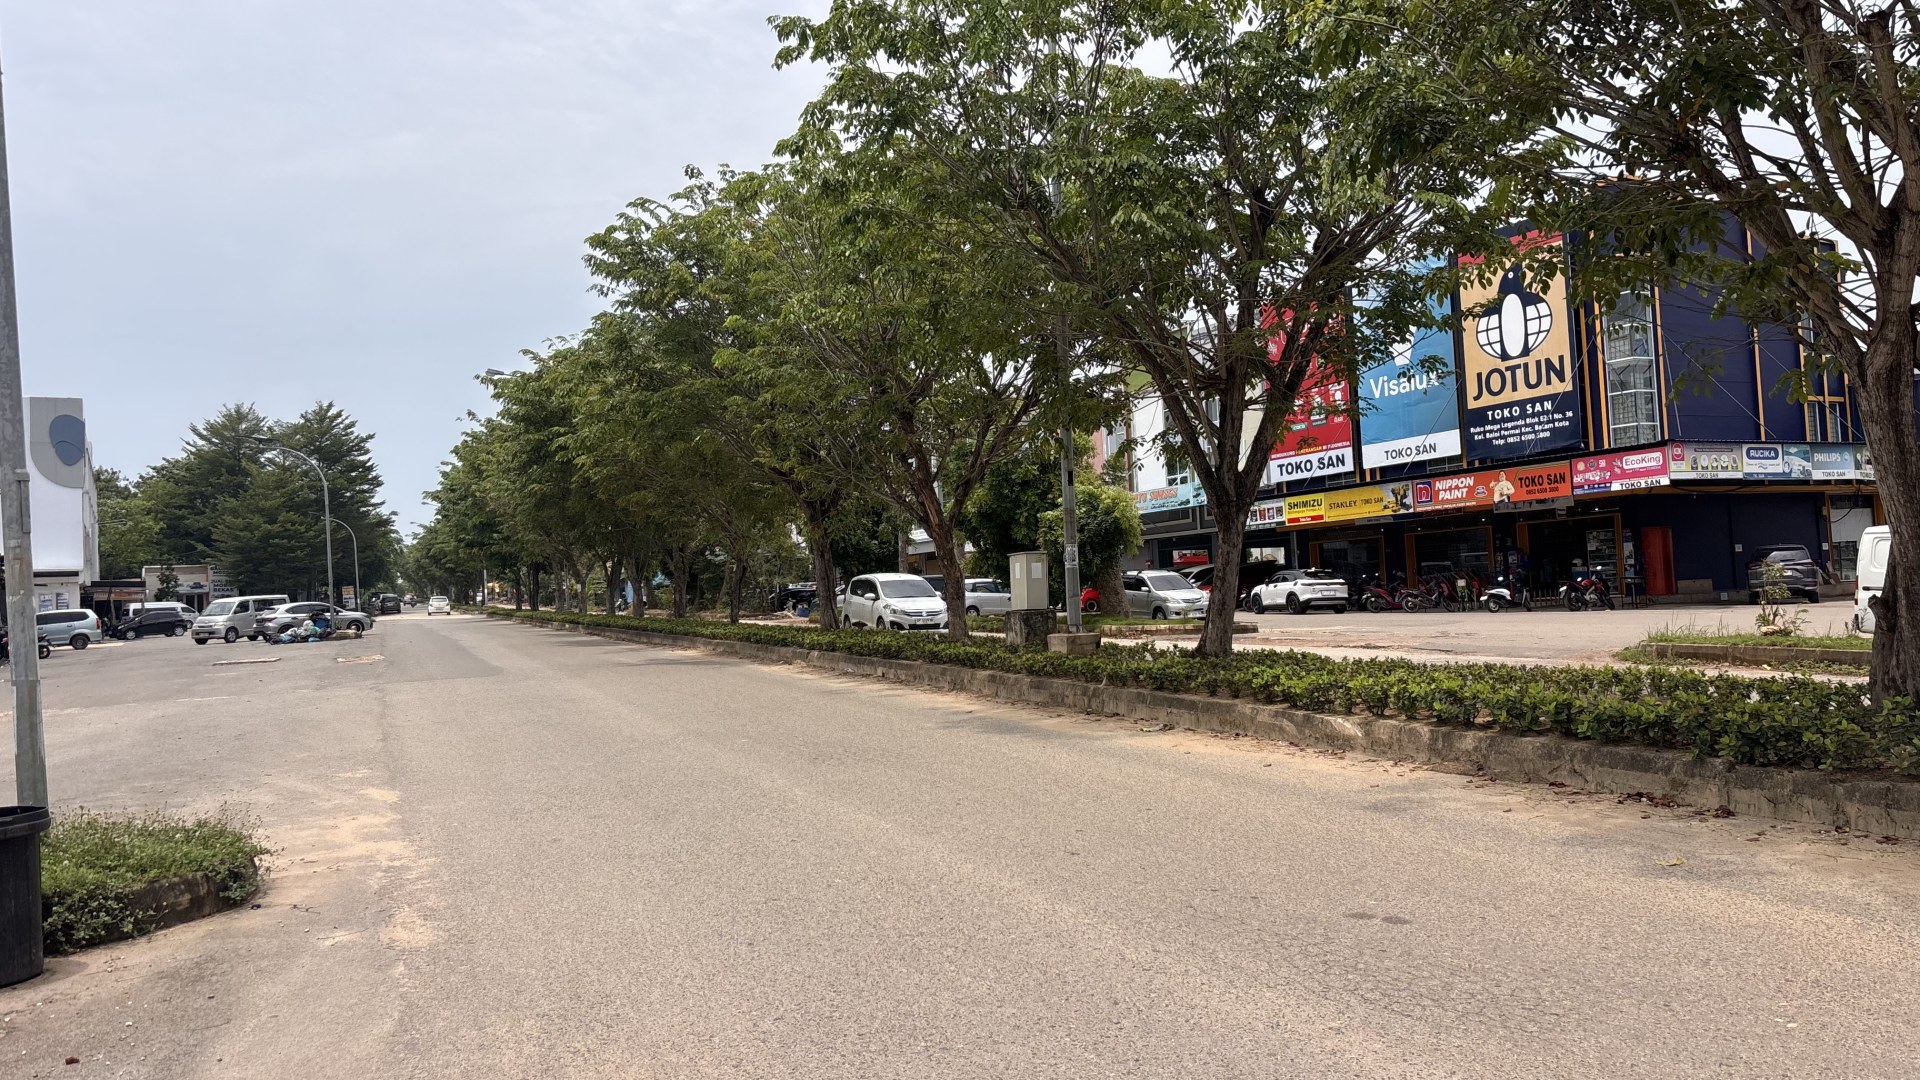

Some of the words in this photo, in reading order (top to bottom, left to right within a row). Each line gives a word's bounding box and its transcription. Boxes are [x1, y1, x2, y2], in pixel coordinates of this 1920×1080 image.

[1473, 355, 1566, 401] JOTUN
[1487, 406, 1520, 421] TOKO
[1526, 400, 1552, 414] SAN
[1470, 426, 1484, 434] Ruko
[1501, 418, 1525, 428] Legenda
[1526, 416, 1539, 424] Blok
[1565, 410, 1573, 418] 36
[1474, 433, 1485, 441] Kel.
[1500, 427, 1521, 437] Permai
[1521, 425, 1534, 433] Kec.
[1554, 420, 1570, 428] Kota
[1492, 438, 1506, 446] Telp:
[1384, 446, 1413, 461] TOKO
[1414, 442, 1437, 456] SAN
[1749, 449, 1776, 458] RUCIKA
[1813, 452, 1841, 462] PHILIPS
[1276, 458, 1314, 478] TOKO
[1316, 453, 1346, 471] SAN
[1624, 454, 1661, 467] EcoKing
[1518, 474, 1544, 489] TOKO
[1546, 472, 1566, 486] SAN
[1859, 471, 1873, 479] TOKO
[1434, 476, 1475, 491] NIPPON
[1619, 481, 1642, 490] TOKO
[1644, 478, 1661, 487] SAN
[1373, 496, 1384, 504] SAN
[1438, 488, 1468, 501] PAINT
[1287, 498, 1323, 511] SHIMIZU
[1328, 500, 1358, 510] STANLEY
